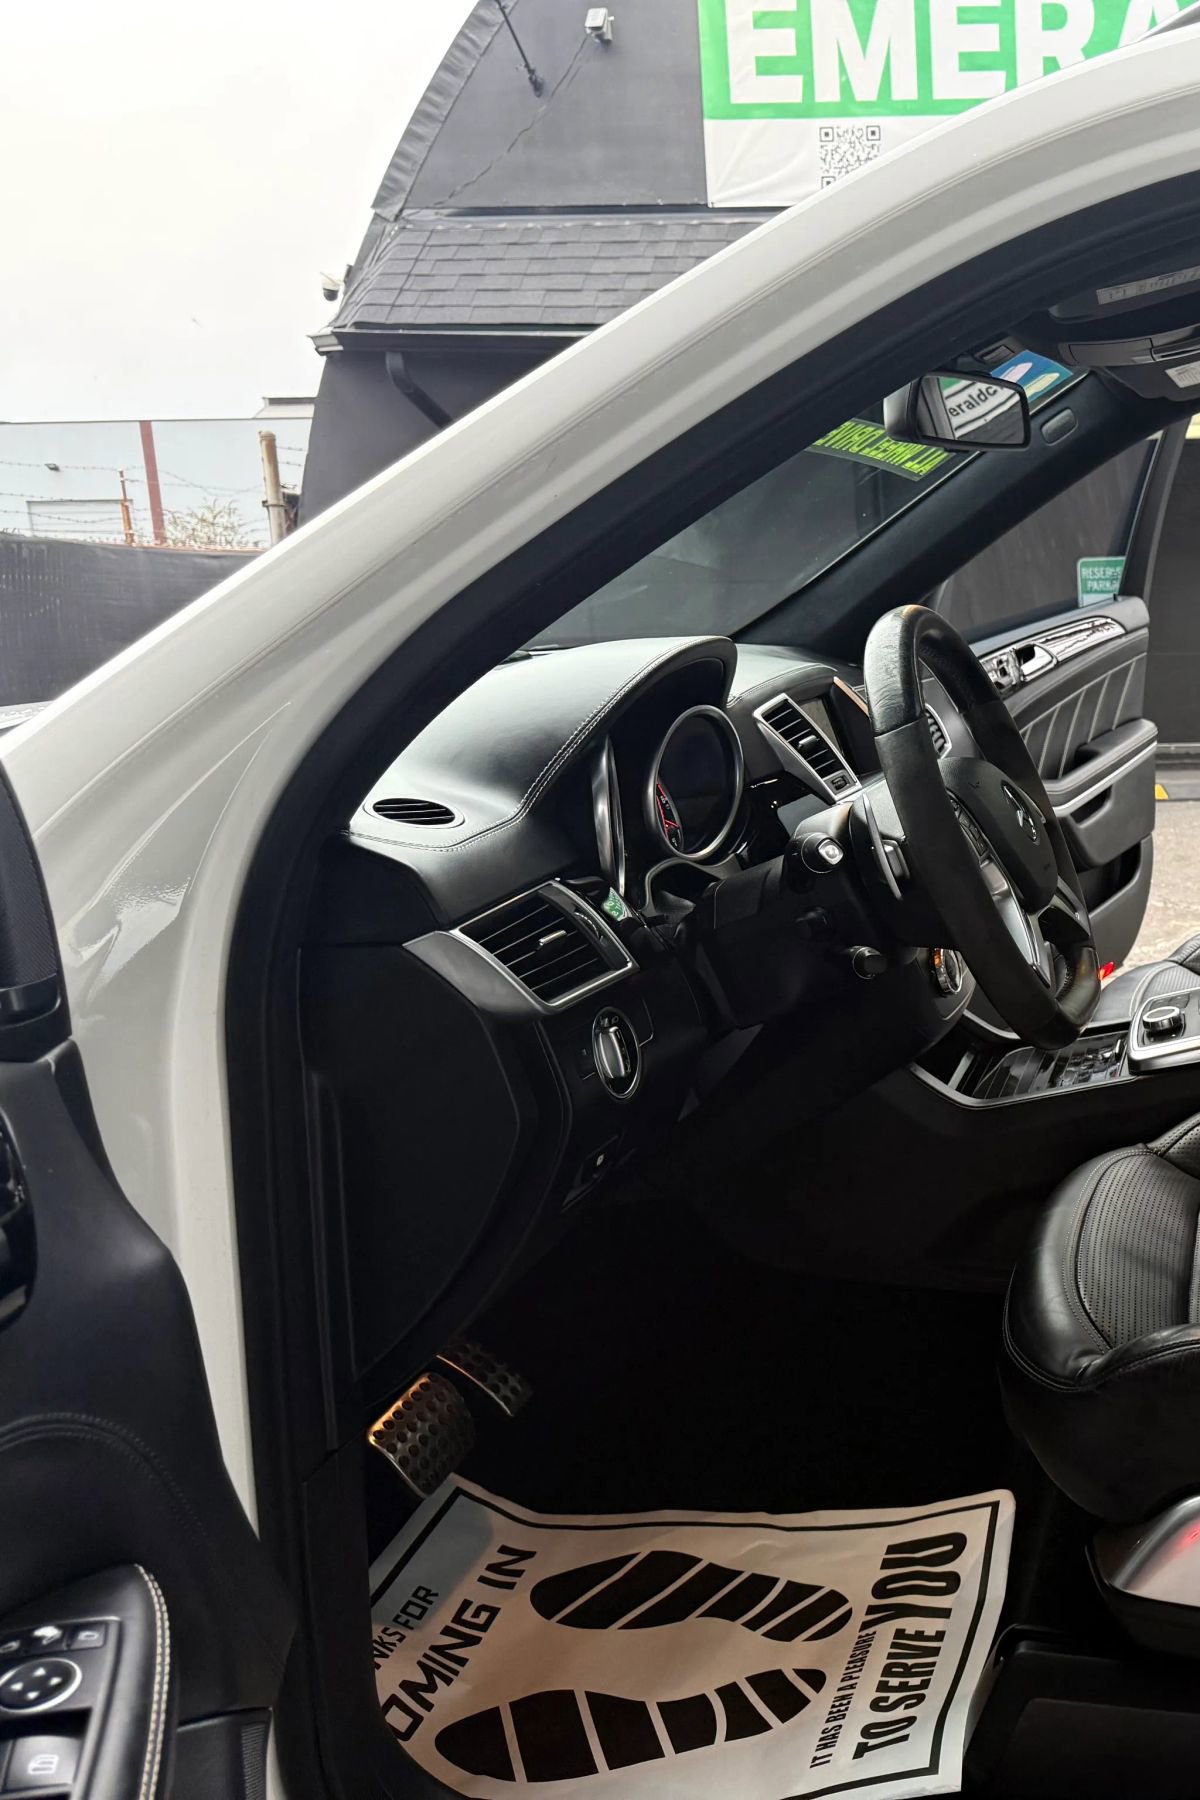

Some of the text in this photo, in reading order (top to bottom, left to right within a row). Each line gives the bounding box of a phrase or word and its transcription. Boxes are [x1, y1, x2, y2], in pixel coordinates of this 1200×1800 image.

[949, 384, 1004, 417] eraldc
[477, 1544, 537, 1590] IN
[373, 1586, 439, 1670] NKS FOR
[852, 1532, 967, 1760] TO SERVE YOU
[810, 1631, 877, 1769] IT HAS BEEN A PLEASURE
